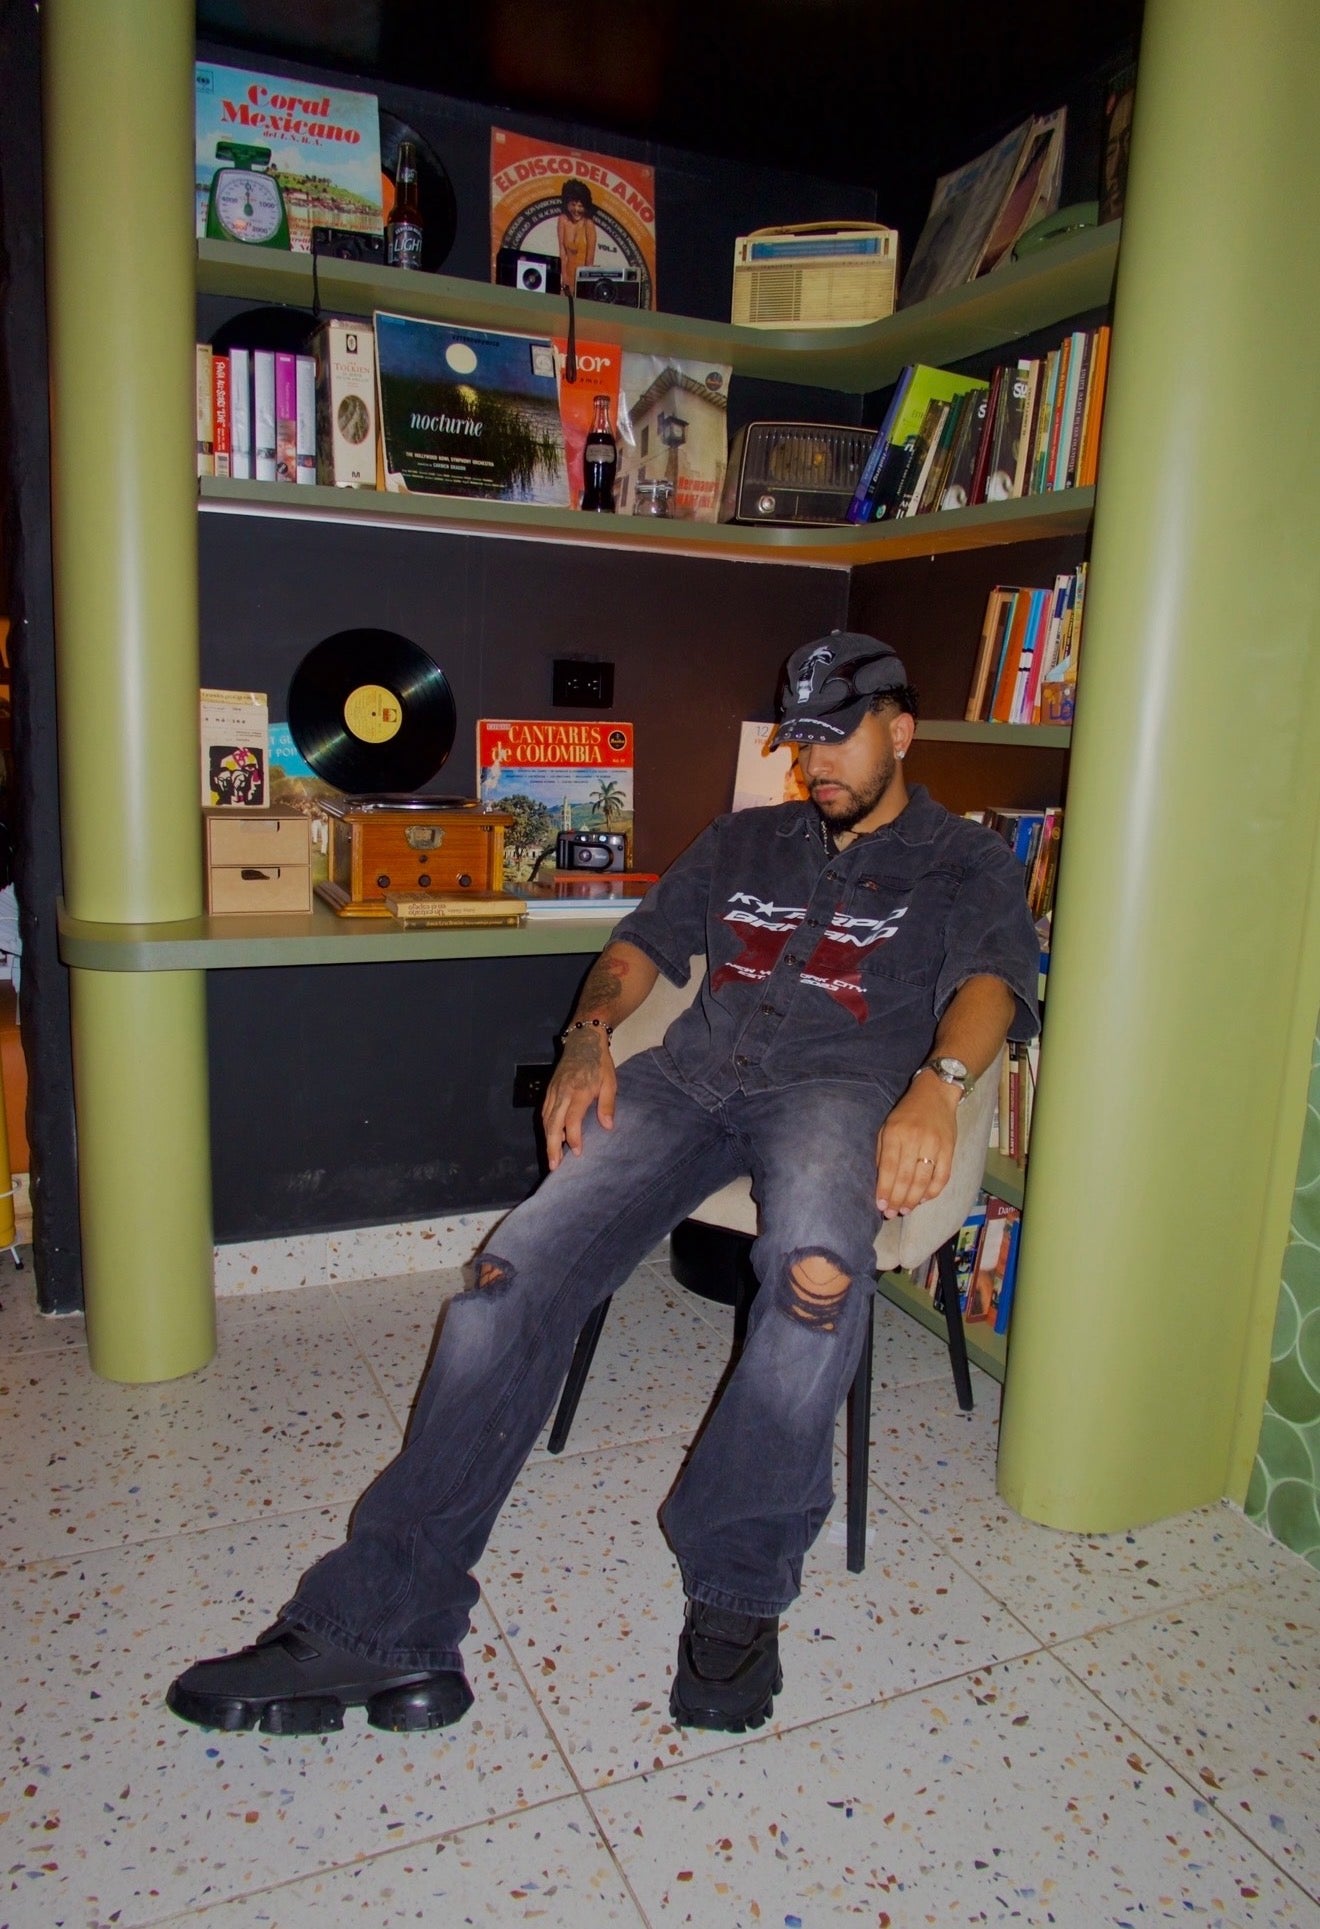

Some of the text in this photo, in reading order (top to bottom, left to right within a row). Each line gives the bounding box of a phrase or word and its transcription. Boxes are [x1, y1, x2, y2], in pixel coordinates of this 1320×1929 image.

[247, 85, 331, 117] Coral
[221, 100, 361, 144] Mexicano
[494, 171, 517, 193] EL
[517, 158, 574, 181] DISCO
[575, 160, 610, 188] DEL
[410, 412, 484, 438] nocturne
[508, 725, 602, 744] CANTARES
[491, 741, 602, 763] de COLOMBIA
